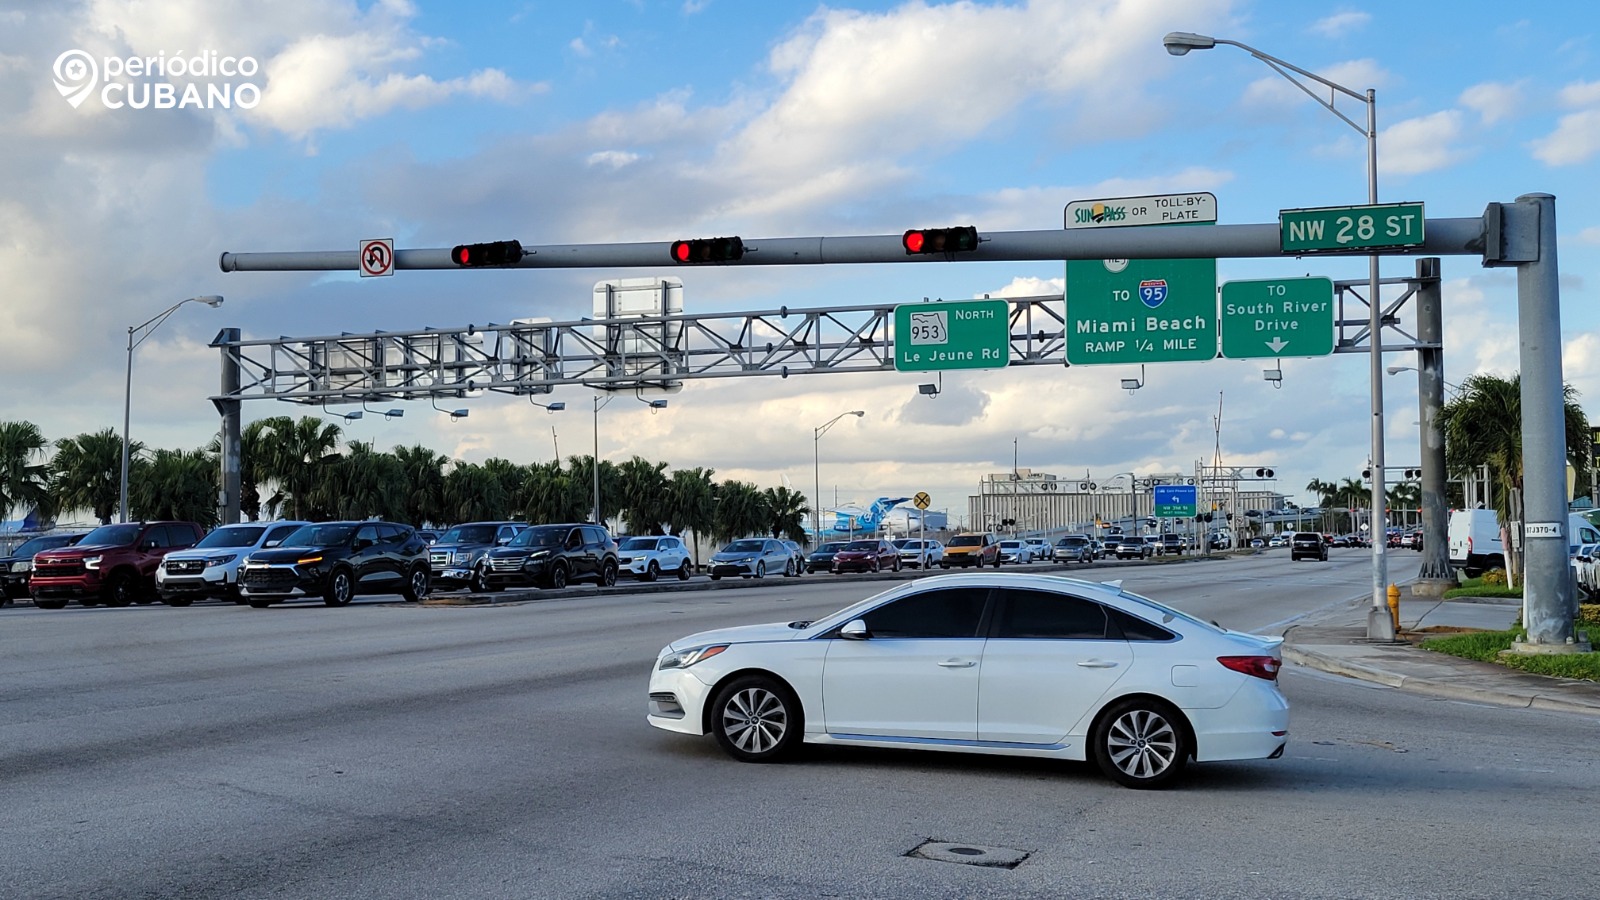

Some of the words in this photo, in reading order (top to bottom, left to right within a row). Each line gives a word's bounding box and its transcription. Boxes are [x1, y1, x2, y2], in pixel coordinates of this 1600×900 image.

[1155, 197, 1206, 208] TOLL-BY-
[1132, 207, 1147, 216] OR
[1162, 210, 1199, 220] PLATE
[1289, 220, 1325, 241] NW
[1335, 215, 1375, 244] 28
[1385, 214, 1415, 237] ST
[1113, 290, 1130, 301] TO
[1143, 287, 1163, 301] 95
[1267, 285, 1286, 296] TO
[955, 310, 994, 320] NORTH
[1226, 303, 1274, 315] South
[1283, 301, 1328, 313] River
[1076, 318, 1136, 334] Miami
[1146, 315, 1206, 331] Beach
[1254, 319, 1299, 331] Drive
[911, 325, 939, 340] 953
[1085, 341, 1125, 353] RAMP
[1163, 338, 1197, 350] MILE
[904, 351, 920, 362] Le
[929, 350, 974, 362] Jeune
[982, 348, 1000, 359] Rd
